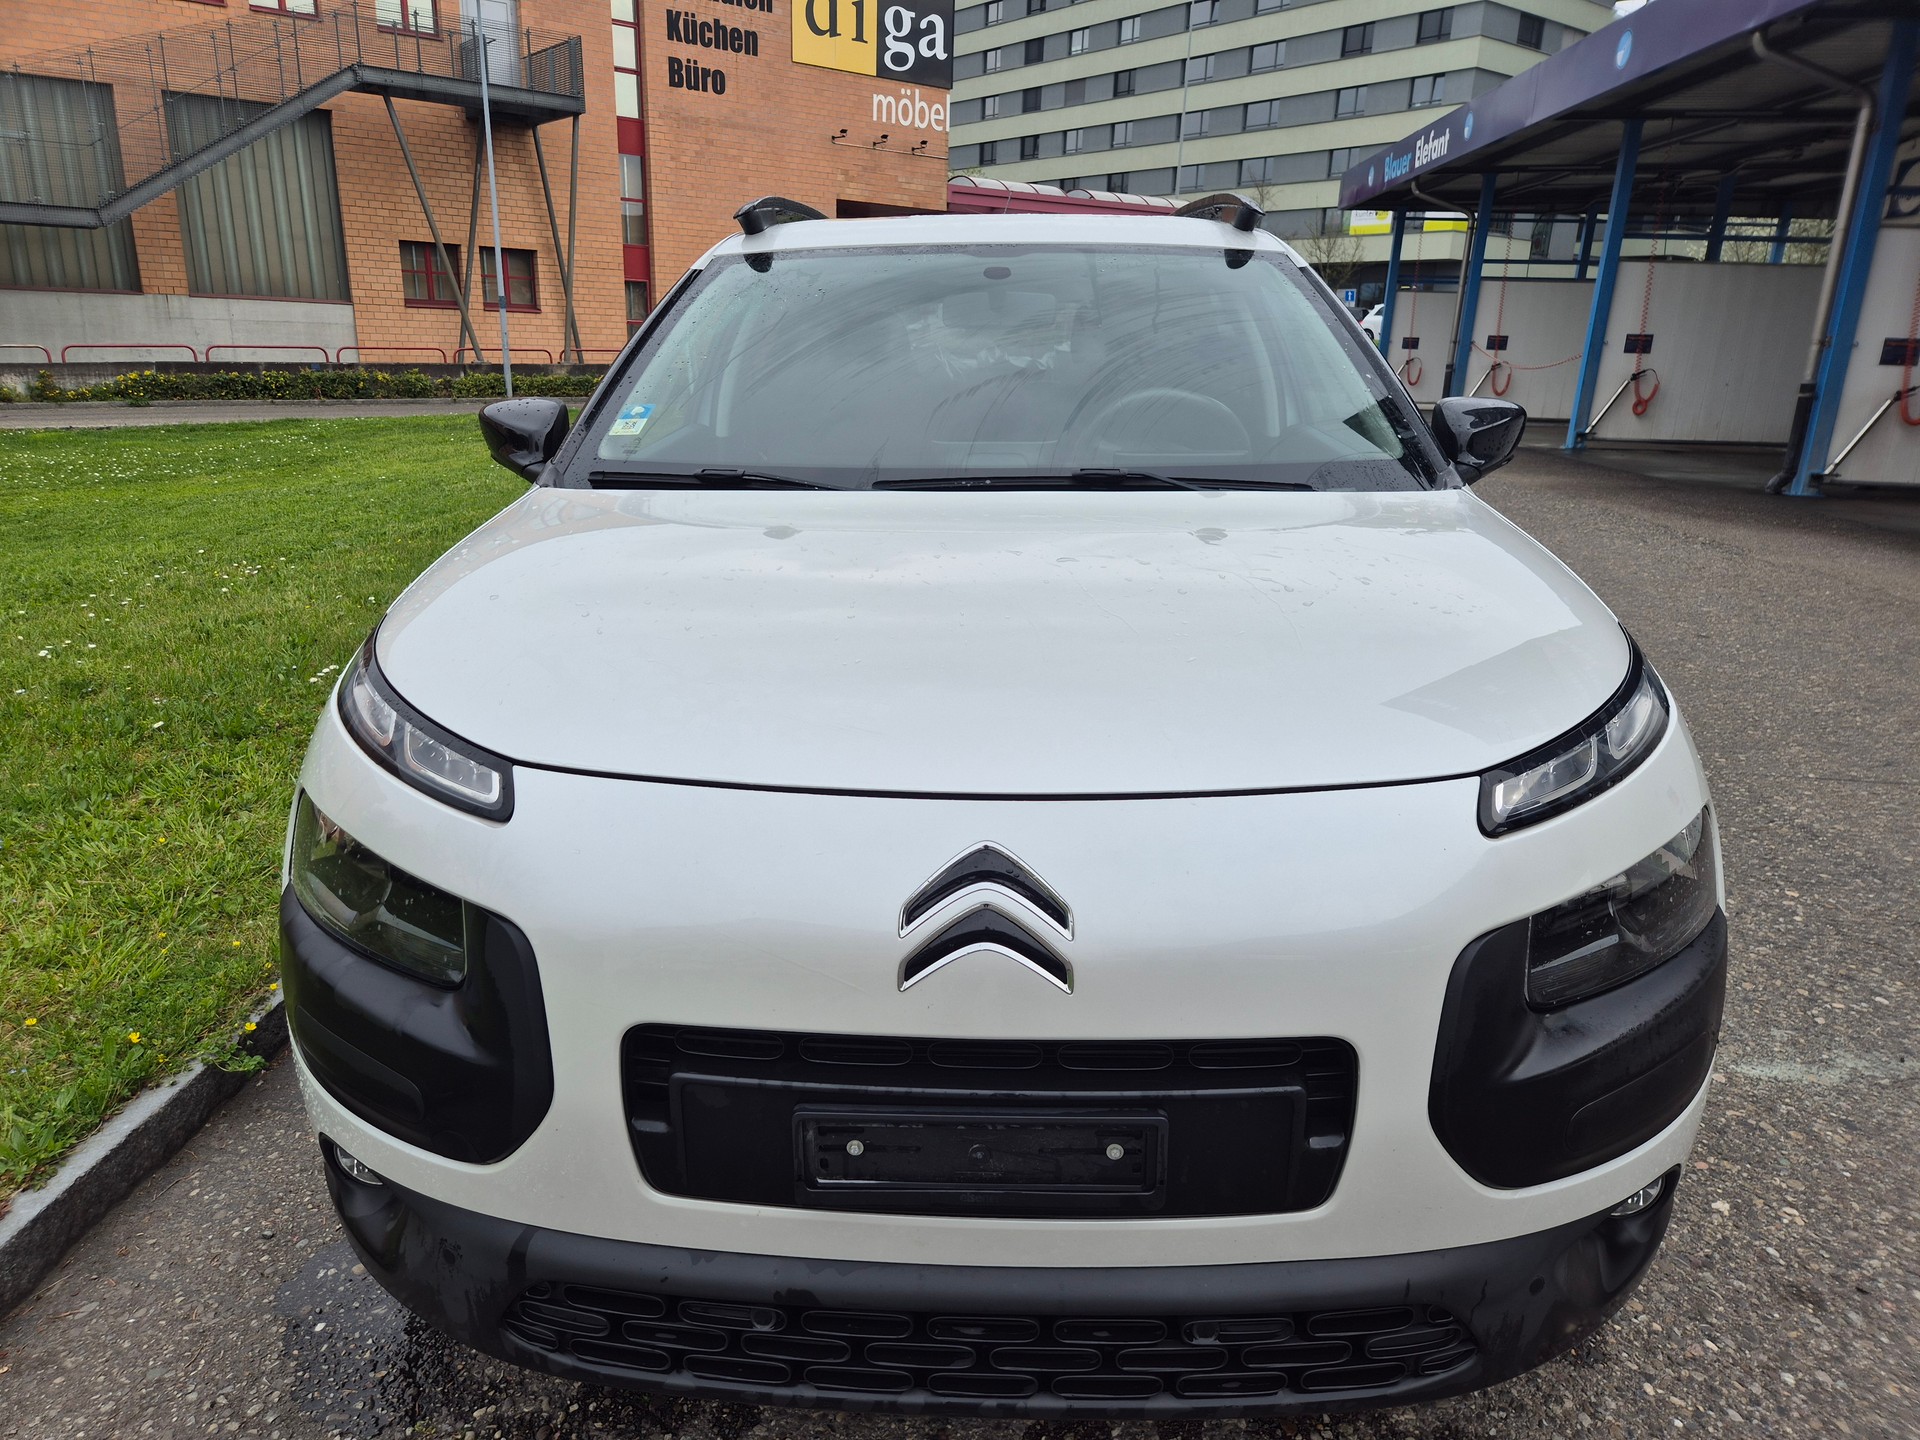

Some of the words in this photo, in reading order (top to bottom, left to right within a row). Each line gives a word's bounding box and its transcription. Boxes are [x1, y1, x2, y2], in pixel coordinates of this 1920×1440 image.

[665, 9, 759, 57] Küchen
[667, 56, 727, 96] Büro
[872, 87, 951, 133] möbel
[1384, 151, 1412, 183] Blauer
[1414, 127, 1450, 169] Elefant
